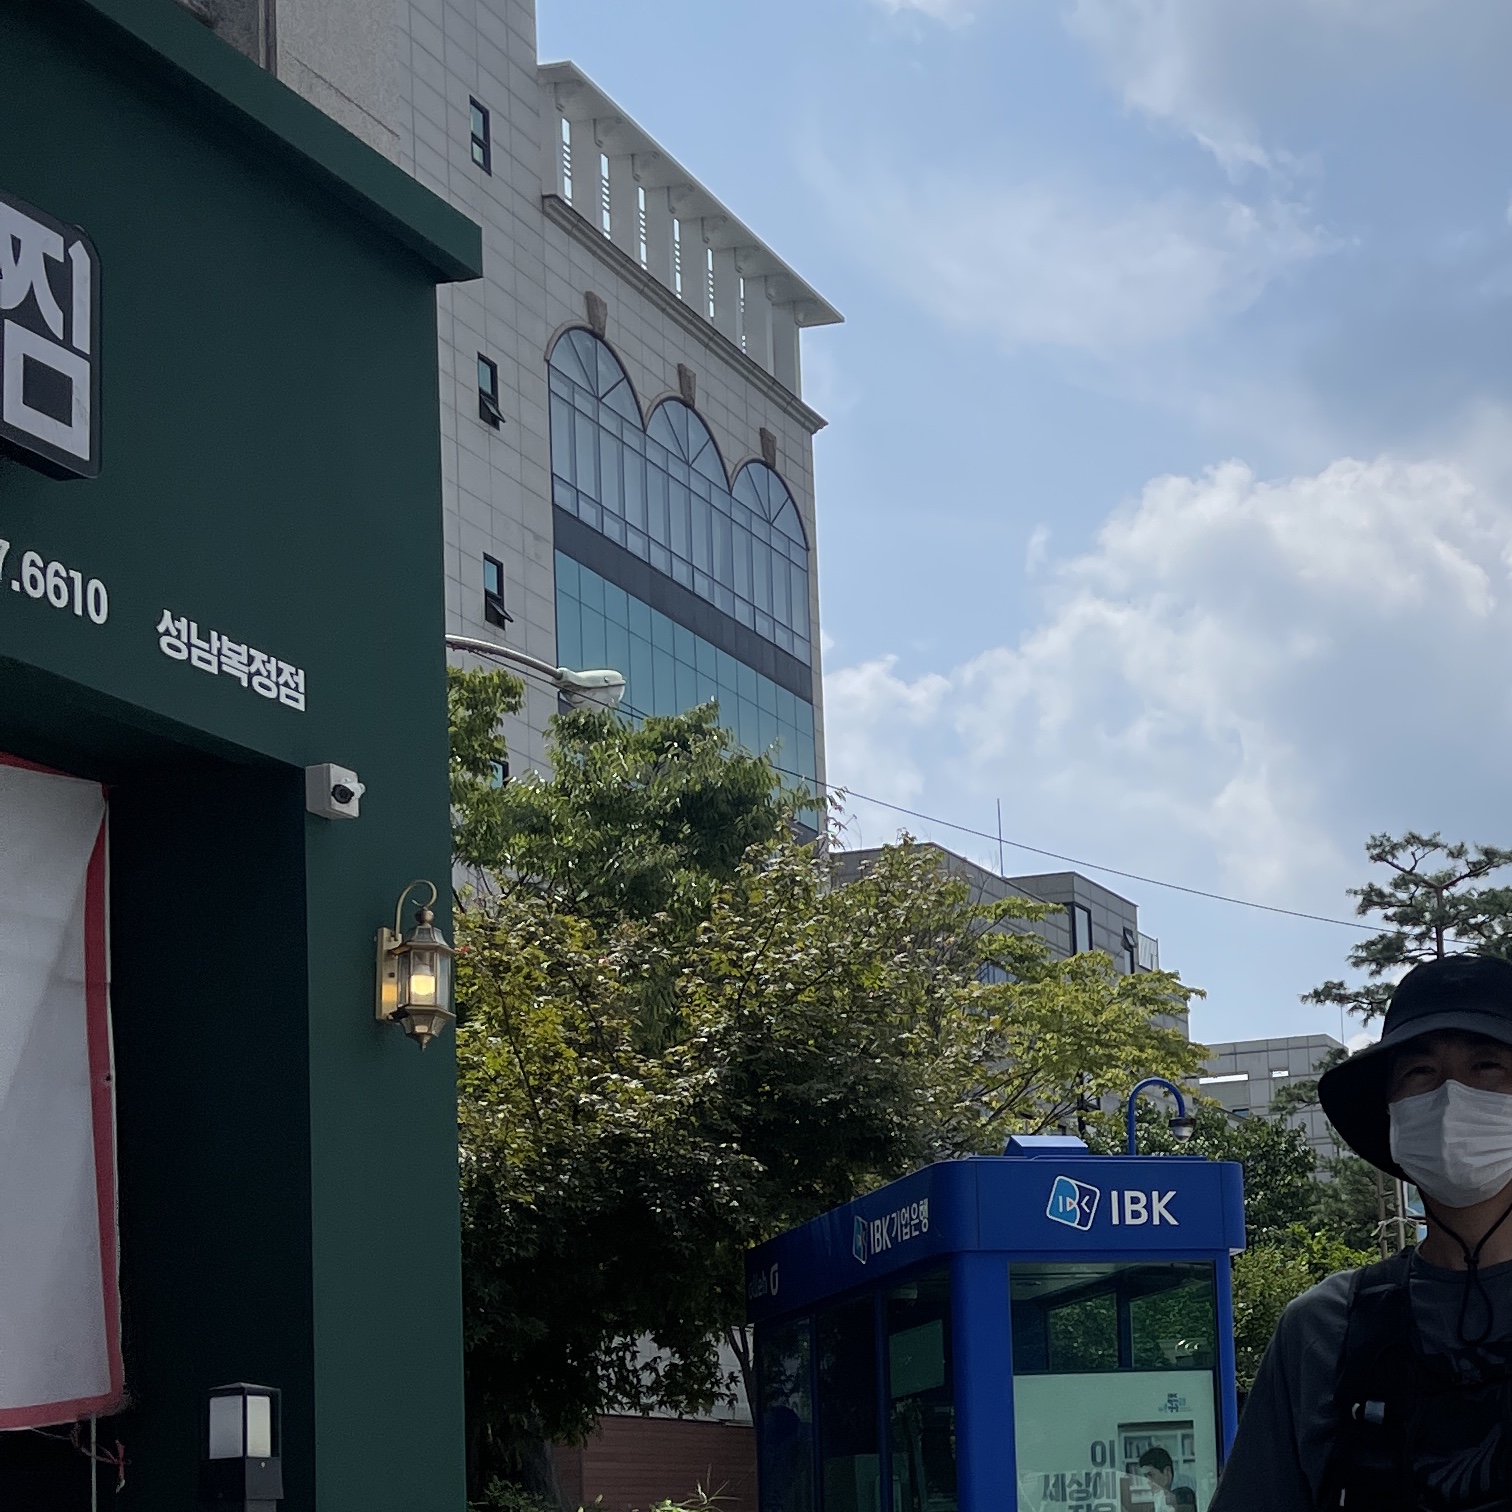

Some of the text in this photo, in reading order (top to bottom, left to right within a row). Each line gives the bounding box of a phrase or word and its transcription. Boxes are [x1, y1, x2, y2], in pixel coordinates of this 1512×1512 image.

[157, 608, 307, 713] 성남복정점
[869, 1197, 930, 1256] IBK기업은행
[1111, 1190, 1180, 1227] IBK
[1090, 1440, 1116, 1469] 이
[1043, 1470, 1118, 1503] 세상에
